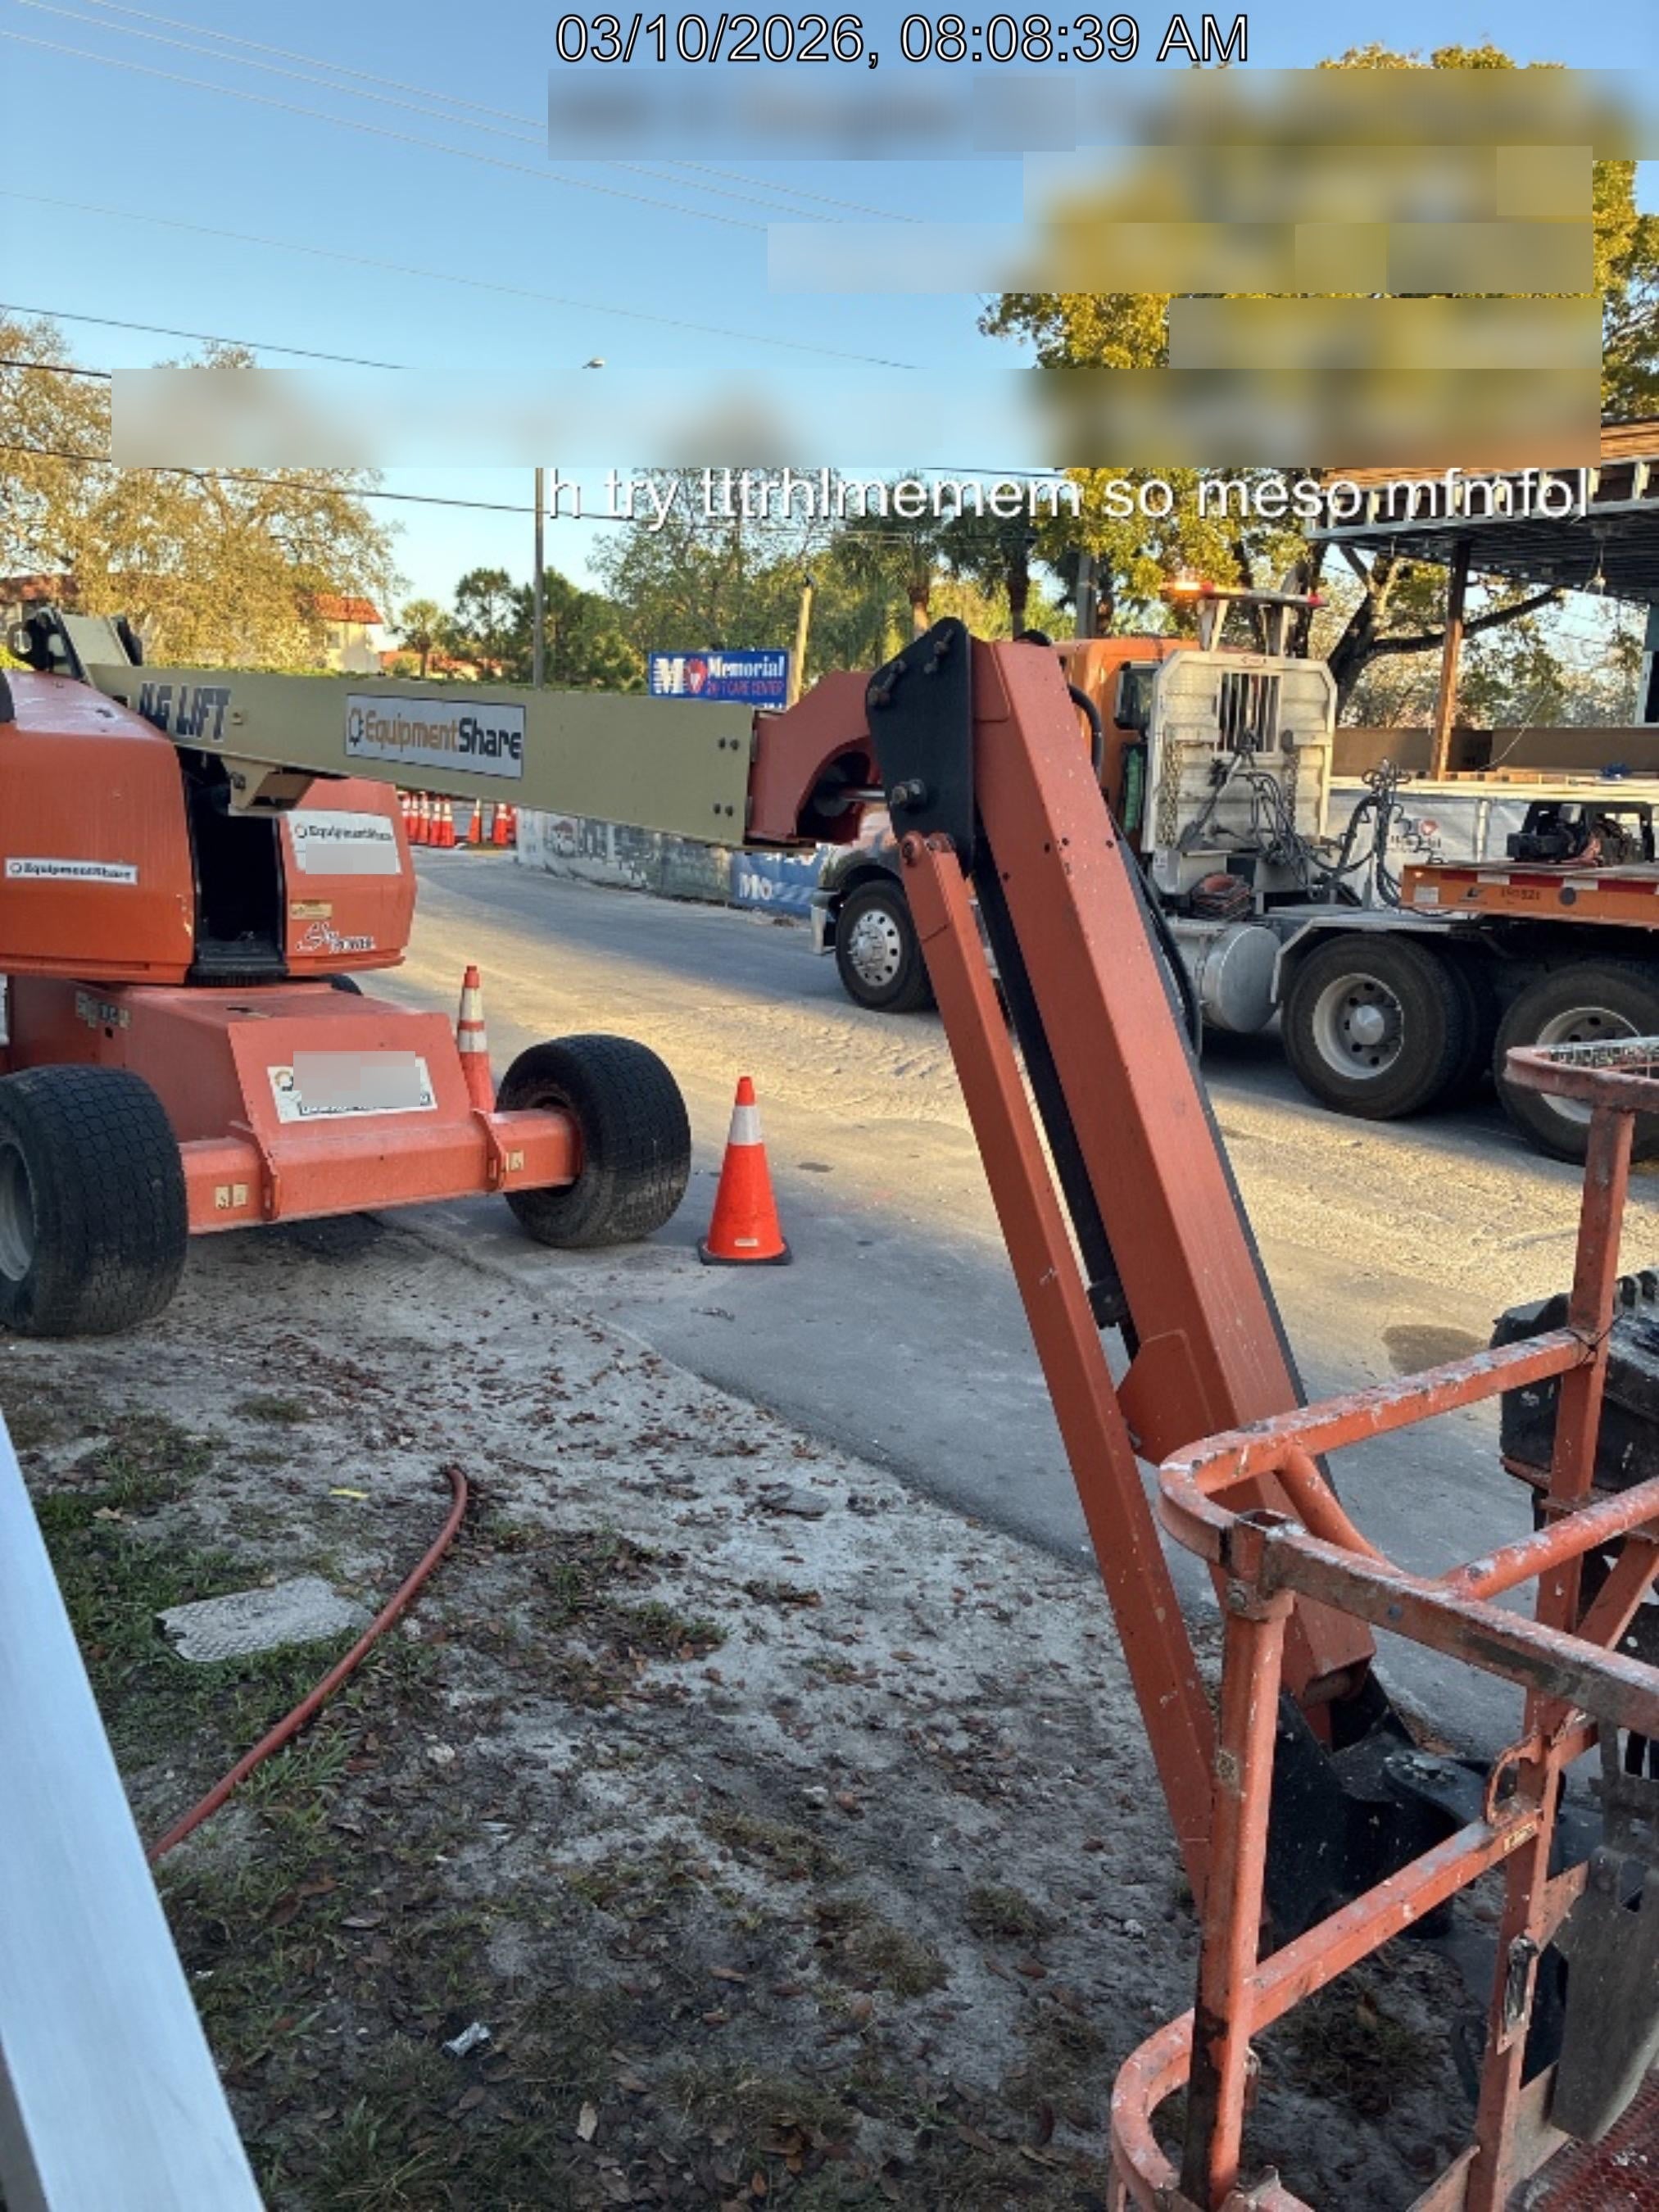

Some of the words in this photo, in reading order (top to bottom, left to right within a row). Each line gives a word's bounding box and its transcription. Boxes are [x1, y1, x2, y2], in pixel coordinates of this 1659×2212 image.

[707, 656, 785, 678] Memorial
[175, 684, 232, 741] LIFT
[365, 709, 522, 760] EquipmentShare
